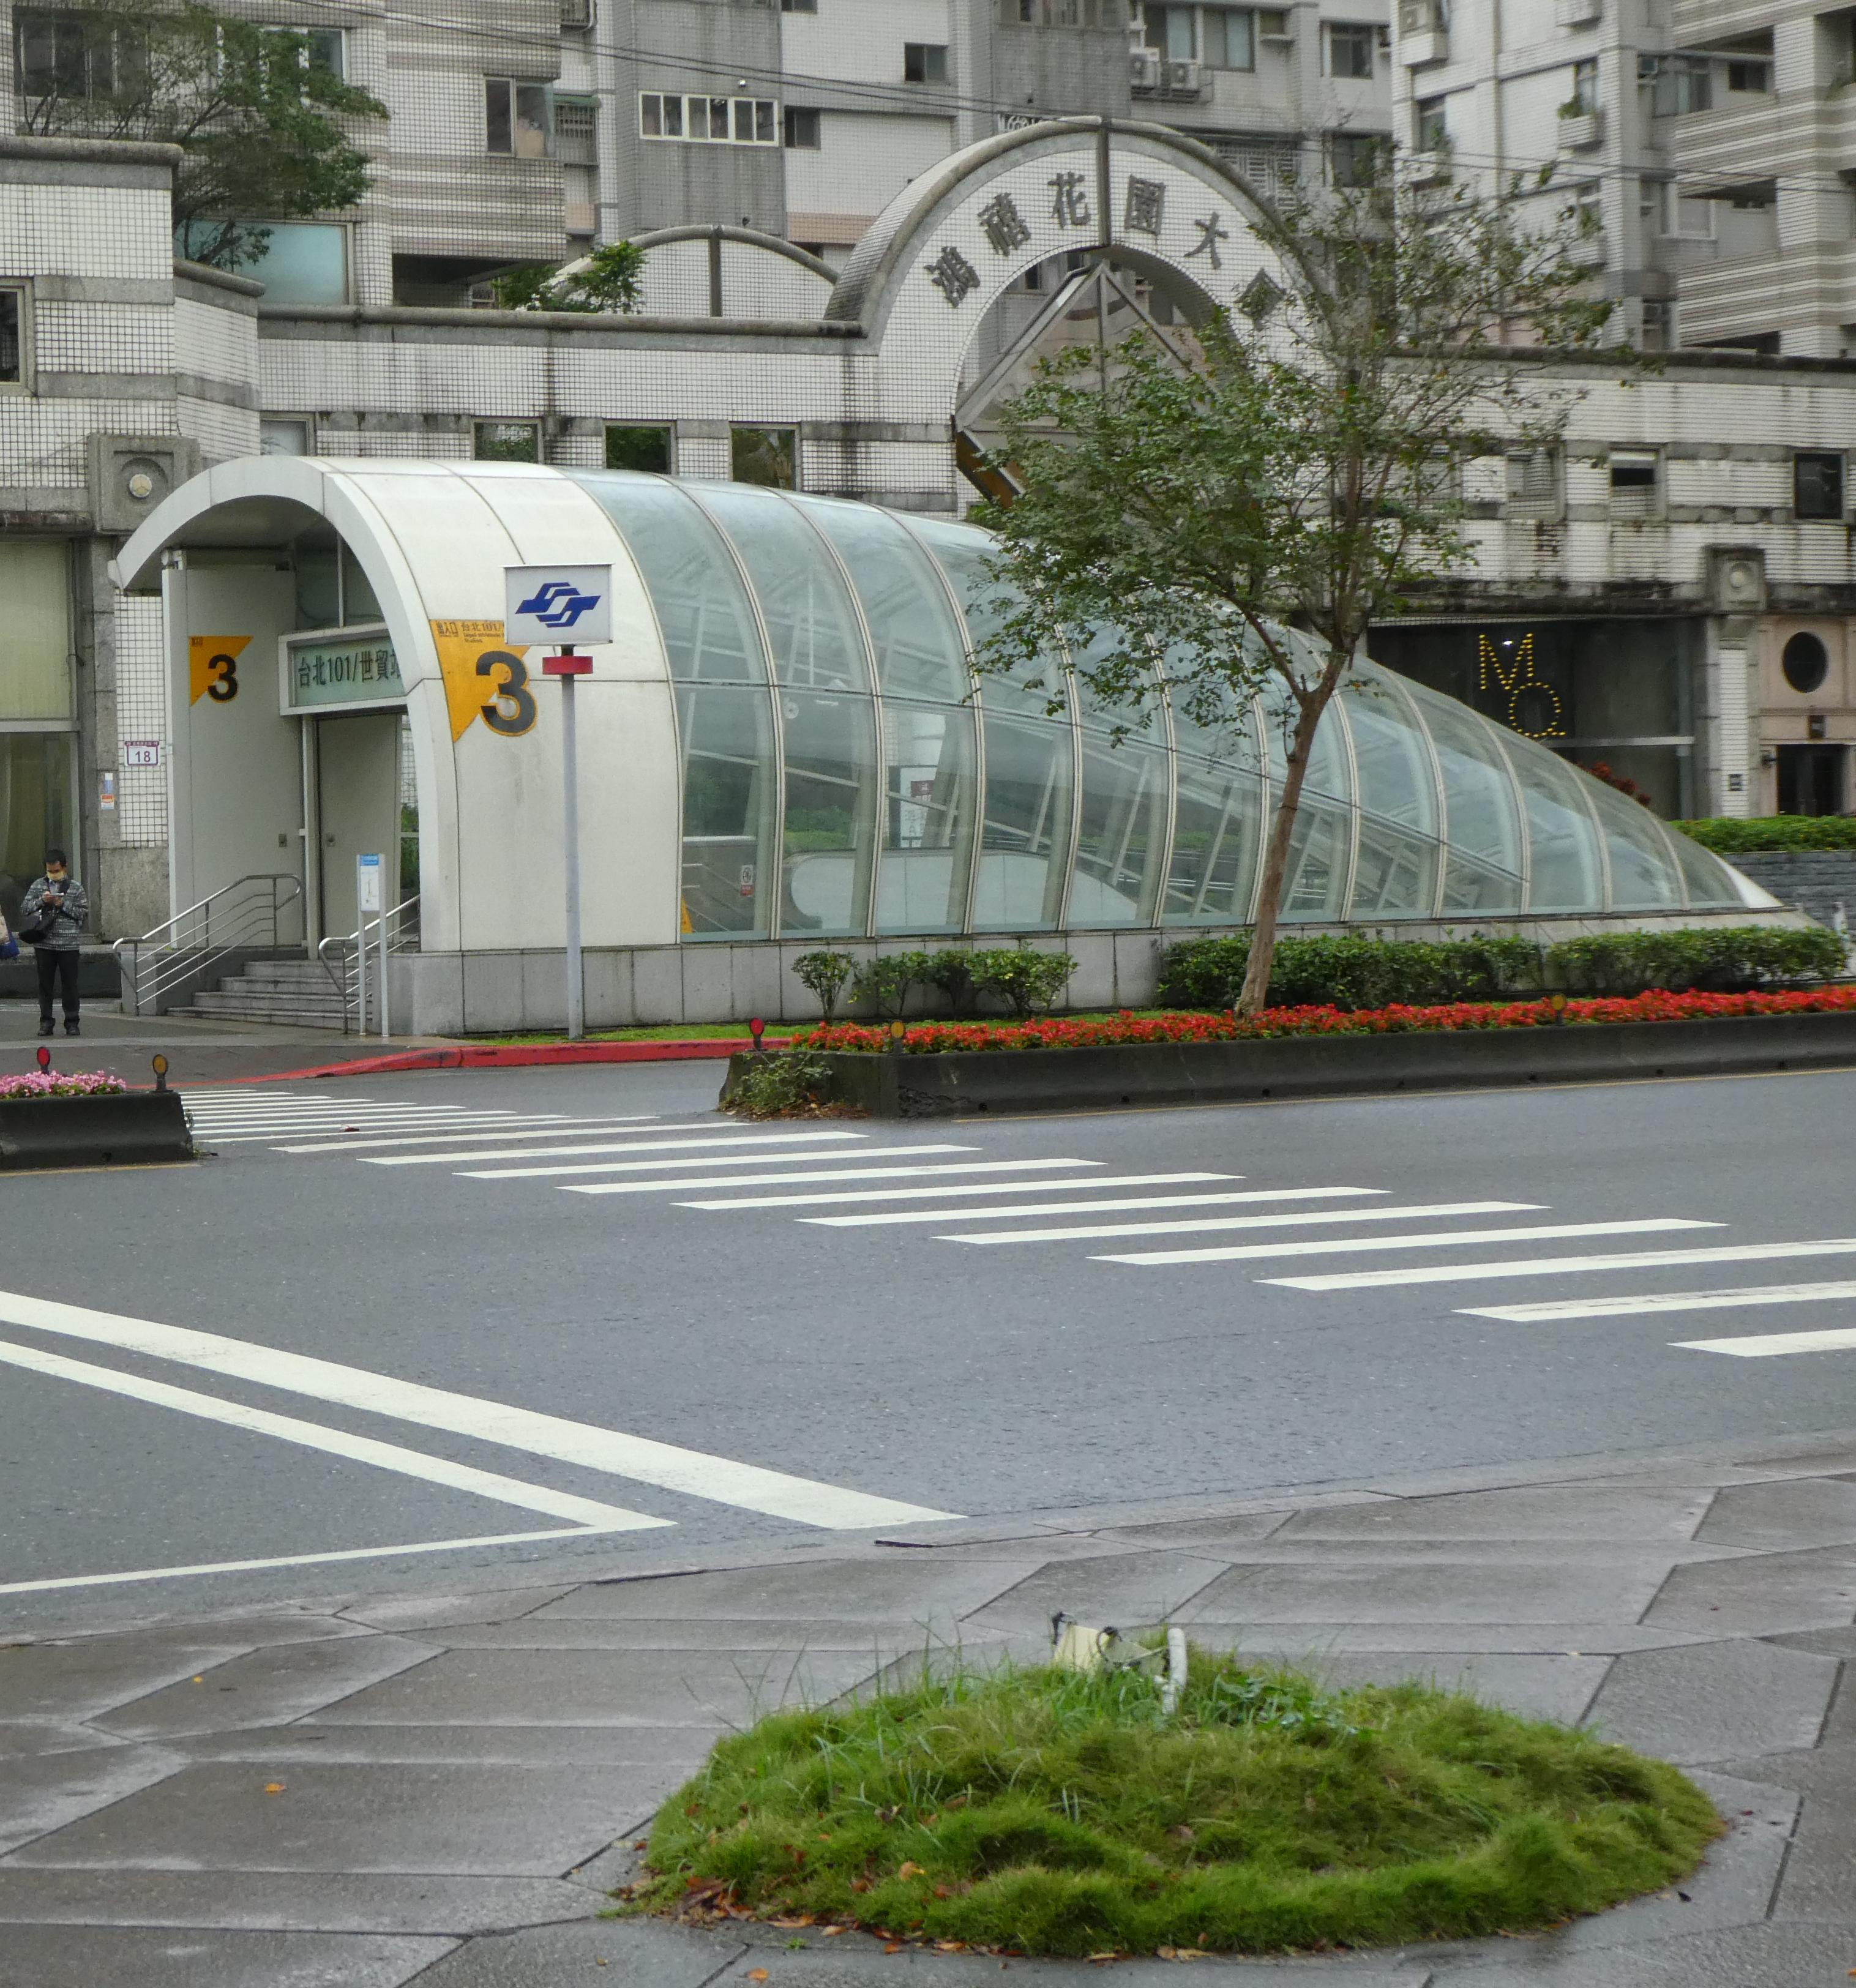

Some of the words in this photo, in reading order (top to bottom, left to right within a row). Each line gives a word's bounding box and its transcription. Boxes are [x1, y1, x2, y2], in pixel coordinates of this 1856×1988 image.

[208, 654, 238, 701] 3
[476, 650, 536, 733] 3
[135, 750, 151, 763] 18
